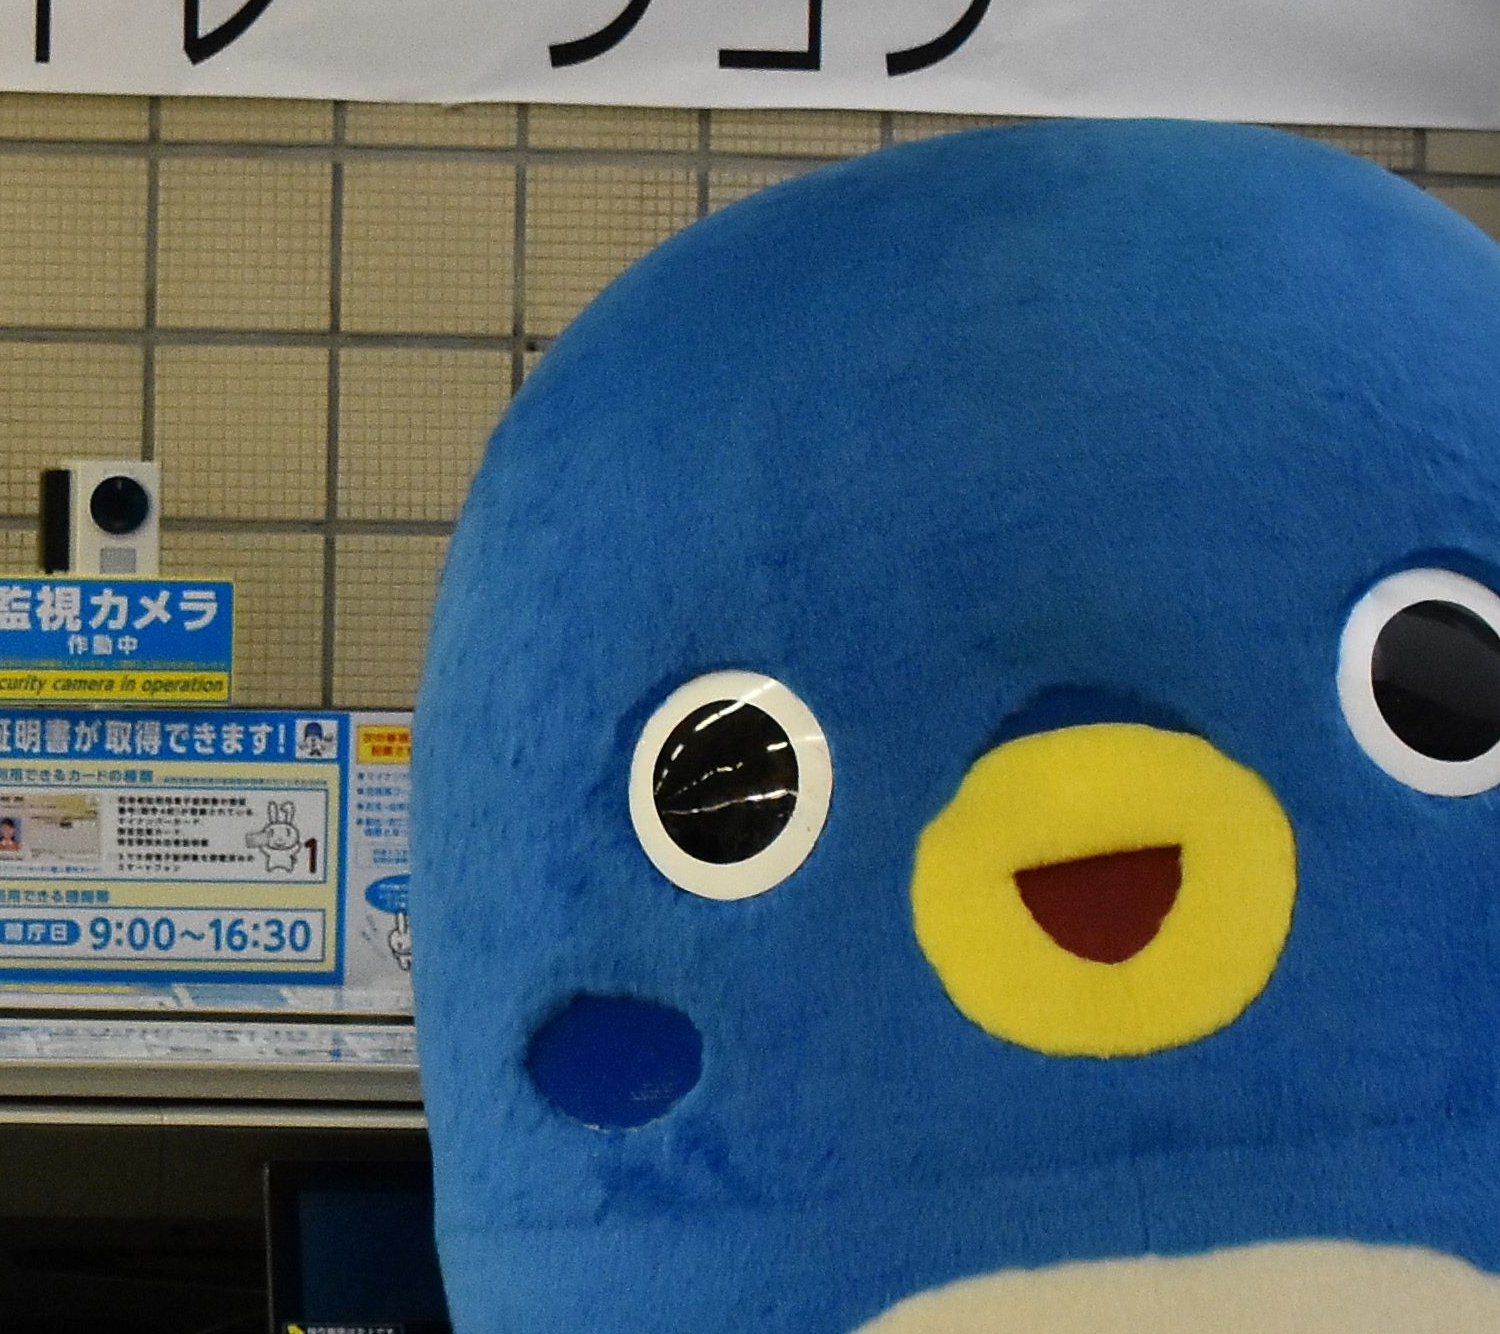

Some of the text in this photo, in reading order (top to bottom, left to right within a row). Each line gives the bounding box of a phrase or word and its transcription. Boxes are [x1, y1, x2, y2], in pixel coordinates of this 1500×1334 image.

[67, 634, 139, 656] 作動中
[51, 676, 115, 692] camera
[120, 674, 136, 691] in
[141, 675, 224, 697] operation
